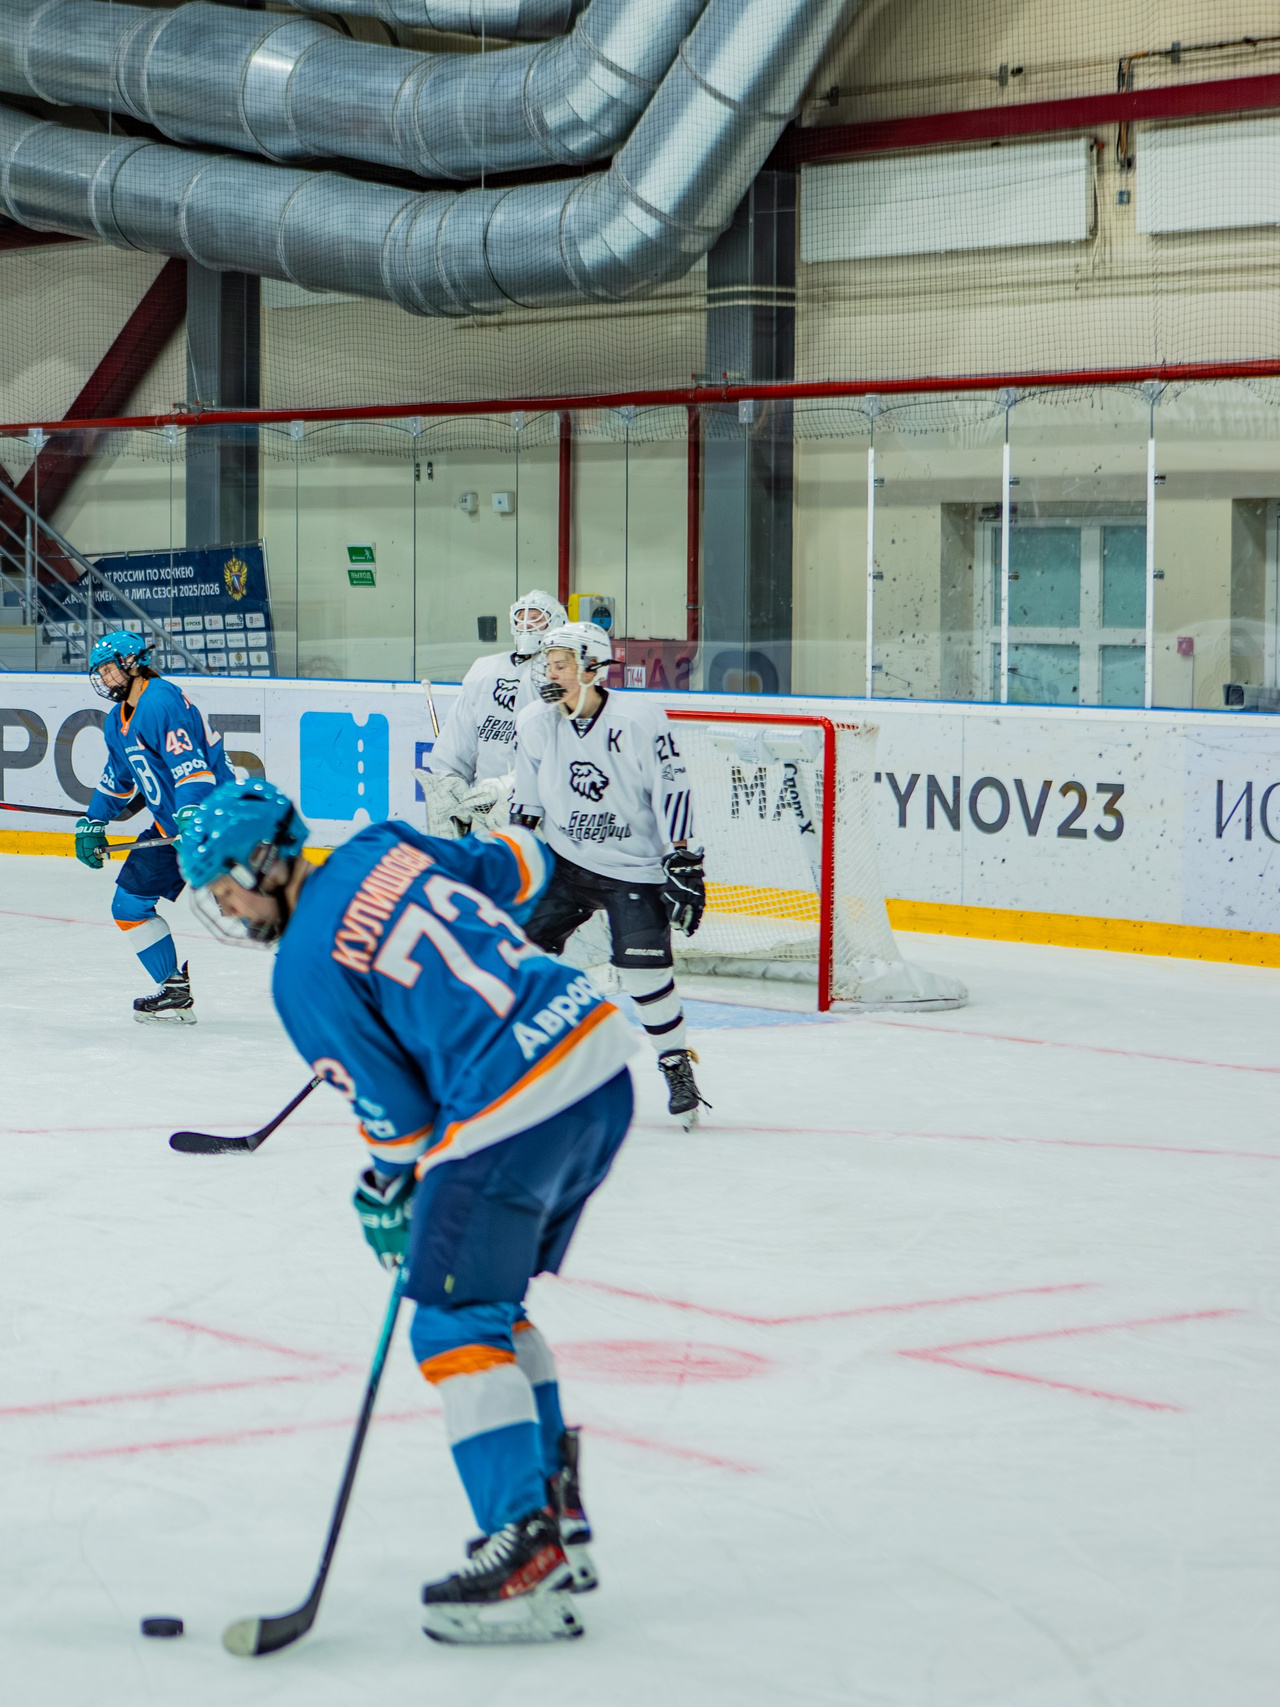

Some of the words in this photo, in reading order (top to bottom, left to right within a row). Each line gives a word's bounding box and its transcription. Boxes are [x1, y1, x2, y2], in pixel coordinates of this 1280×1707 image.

[113, 571, 145, 583] РОССИИ
[147, 569, 158, 581] ПО
[131, 588, 151, 600] ЛИГА
[179, 583, 220, 597] 2025/2026
[482, 715, 516, 731] Белы
[166, 728, 194, 756] 43
[373, 874, 547, 1019] 73
